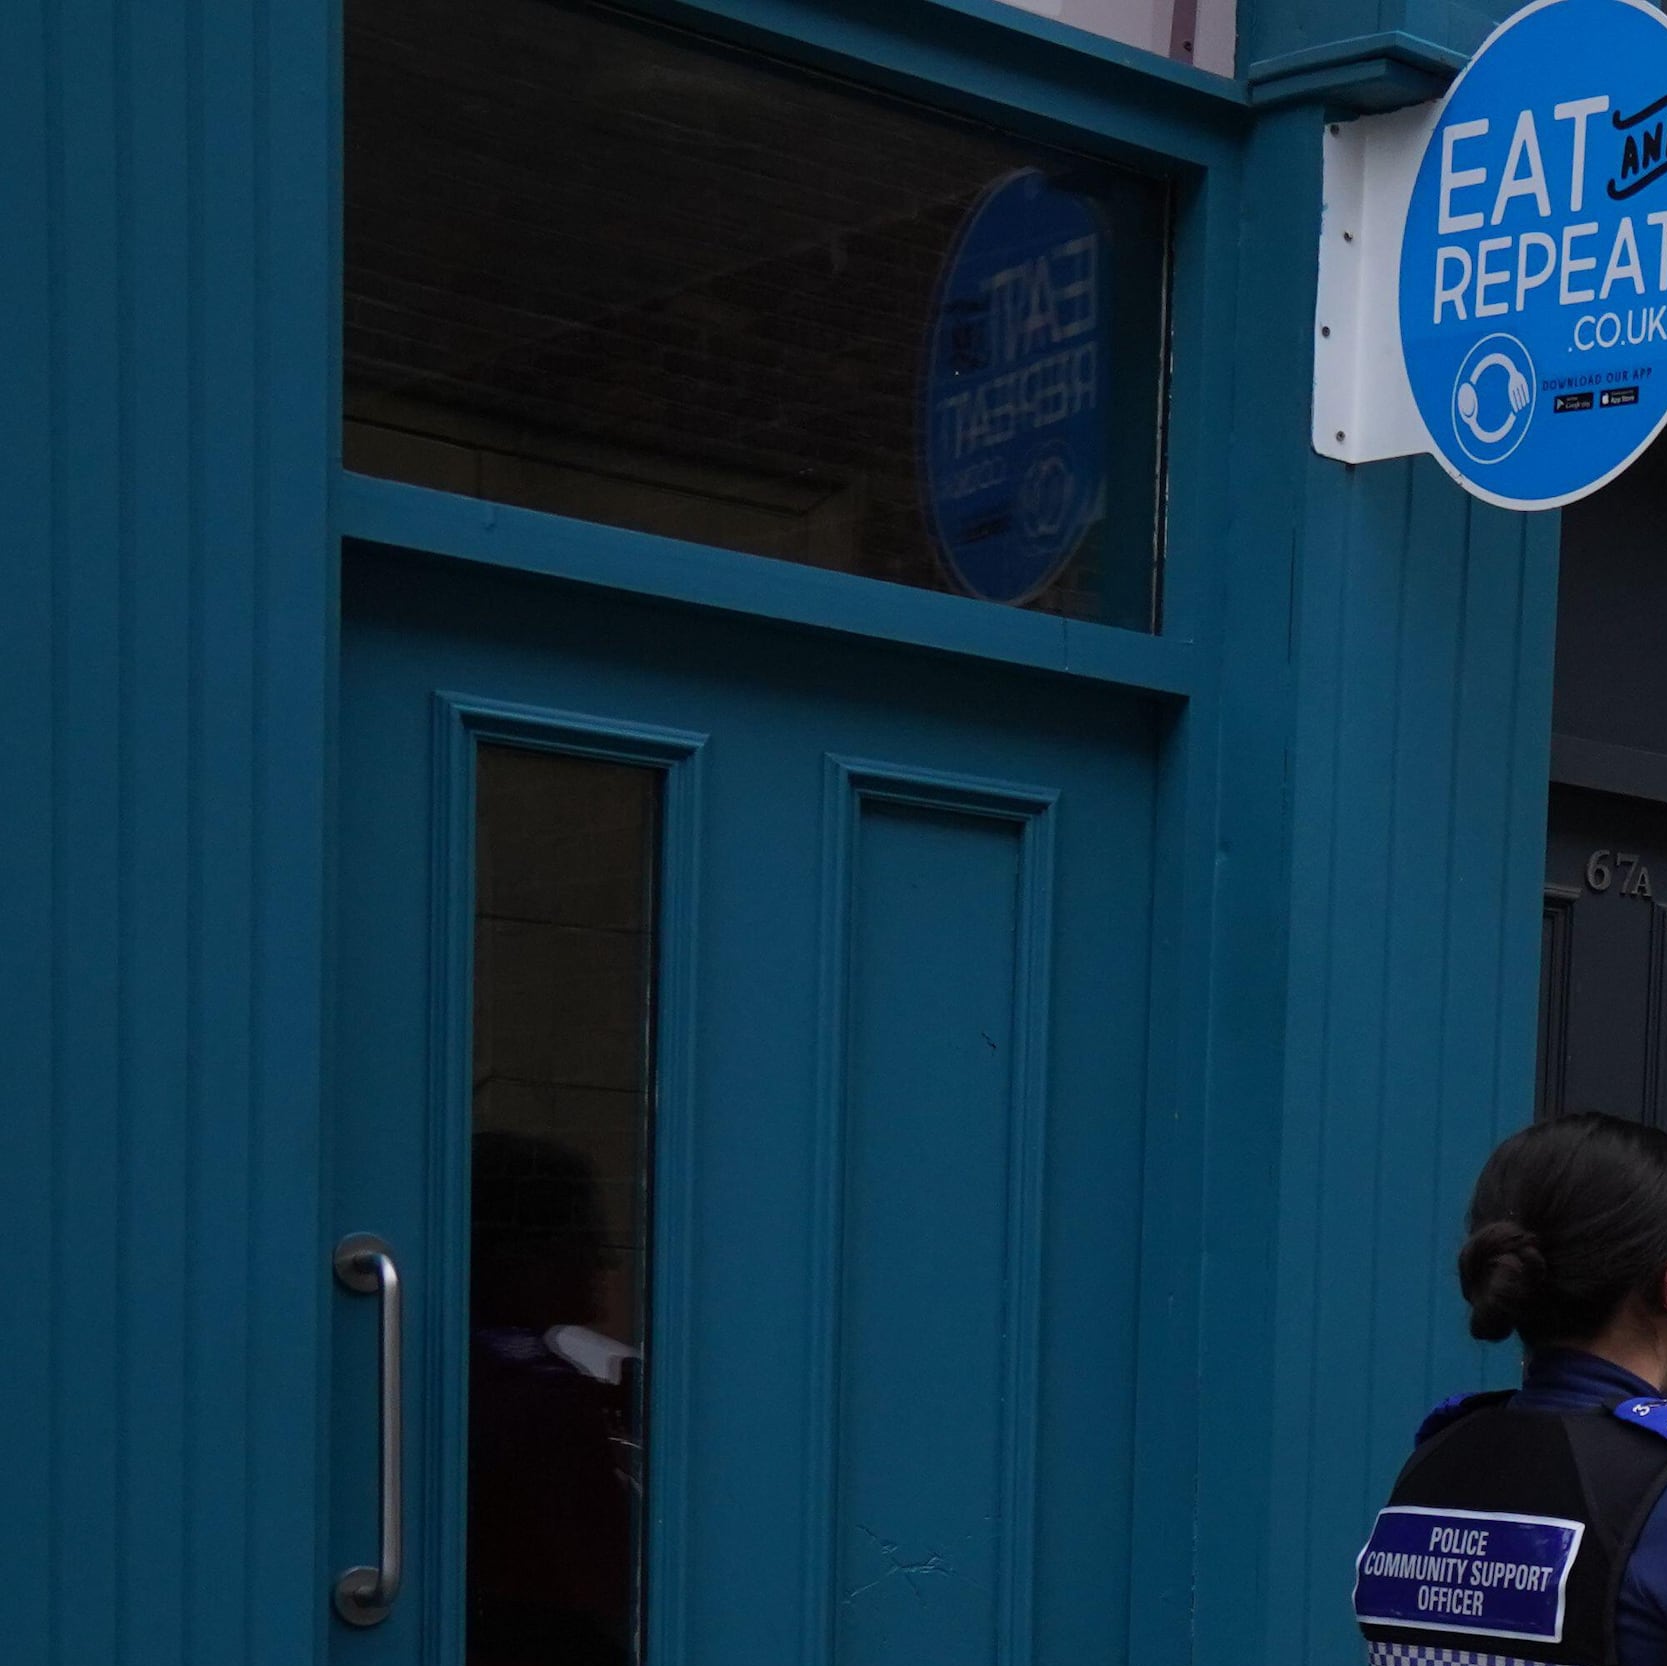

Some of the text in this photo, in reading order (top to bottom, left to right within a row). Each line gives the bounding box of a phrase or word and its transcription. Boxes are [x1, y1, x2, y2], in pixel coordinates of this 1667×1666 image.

[1438, 94, 1610, 235] EAT
[1568, 305, 1667, 353] .CO.UK
[1542, 367, 1652, 391] DOWNLOAD OUR APP
[1586, 849, 1652, 898] 67A
[1429, 1527, 1489, 1556] POLICE
[1364, 1552, 1553, 1592] COMMUNITY SUPPORT
[1418, 1585, 1484, 1616] OFFICER
